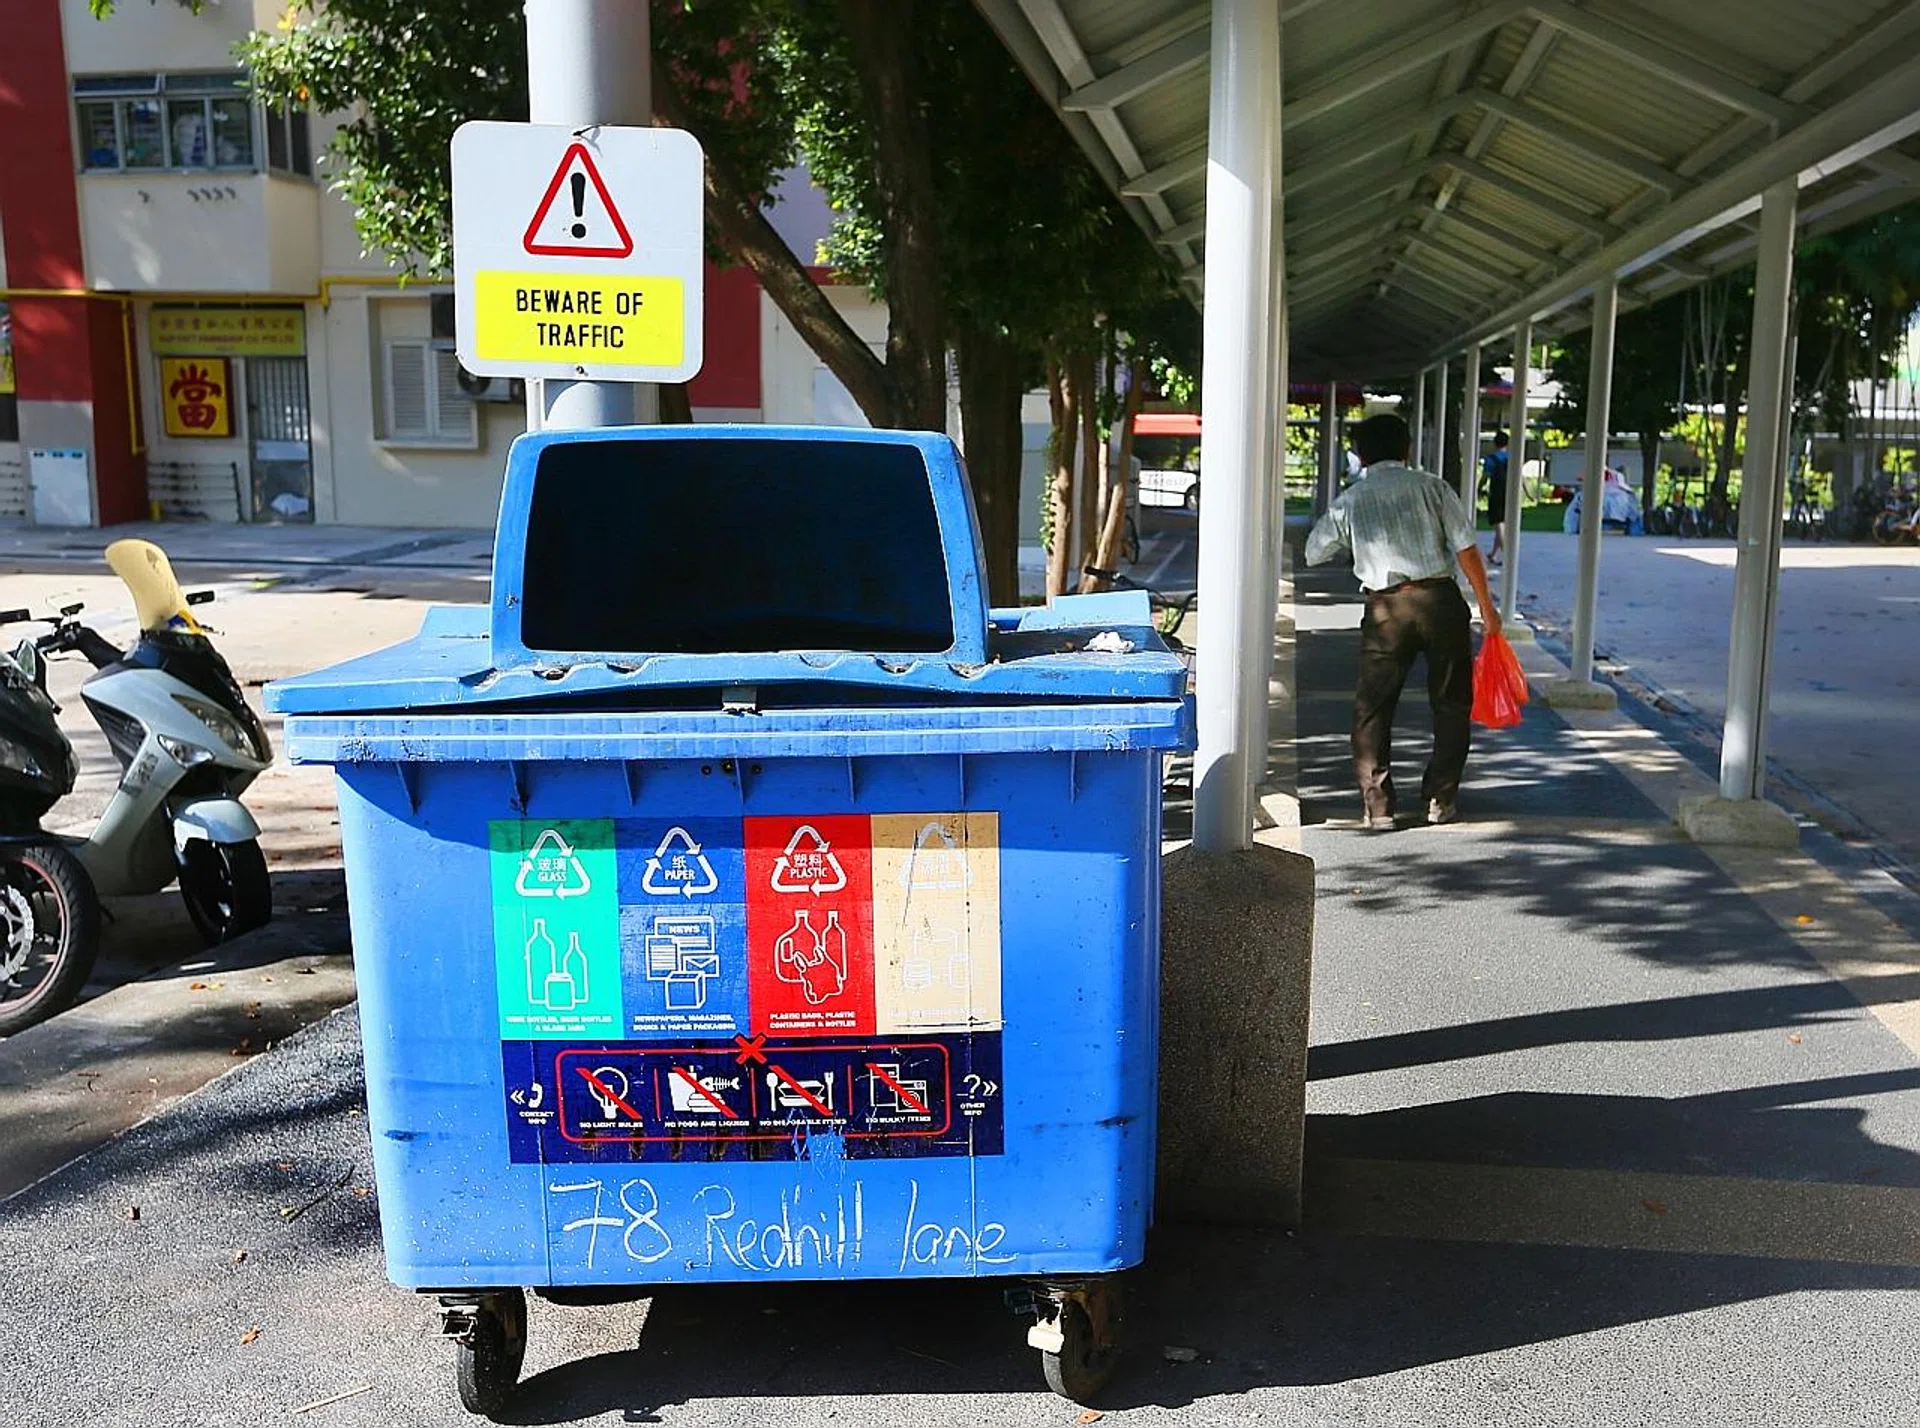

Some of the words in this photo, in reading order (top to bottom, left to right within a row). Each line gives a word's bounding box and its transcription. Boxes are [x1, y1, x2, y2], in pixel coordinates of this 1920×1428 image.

[516, 289, 602, 314] BEWARE
[616, 292, 643, 315] OF
[537, 322, 624, 348] TRAFFIC
[672, 855, 687, 869] 纸
[538, 871, 567, 882] GLASS
[664, 869, 696, 881] PAPER
[790, 867, 828, 879] PLASTIC
[669, 925, 700, 933] NEWS
[769, 1012, 801, 1021] PLASTIC
[825, 1011, 856, 1019] PLASTIC
[667, 1023, 693, 1031] PAPER
[769, 1021, 816, 1029] CONTAINERS
[825, 1020, 856, 1028] BOTTLES
[677, 1120, 699, 1128] FOOD
[549, 1178, 673, 1269] 78
